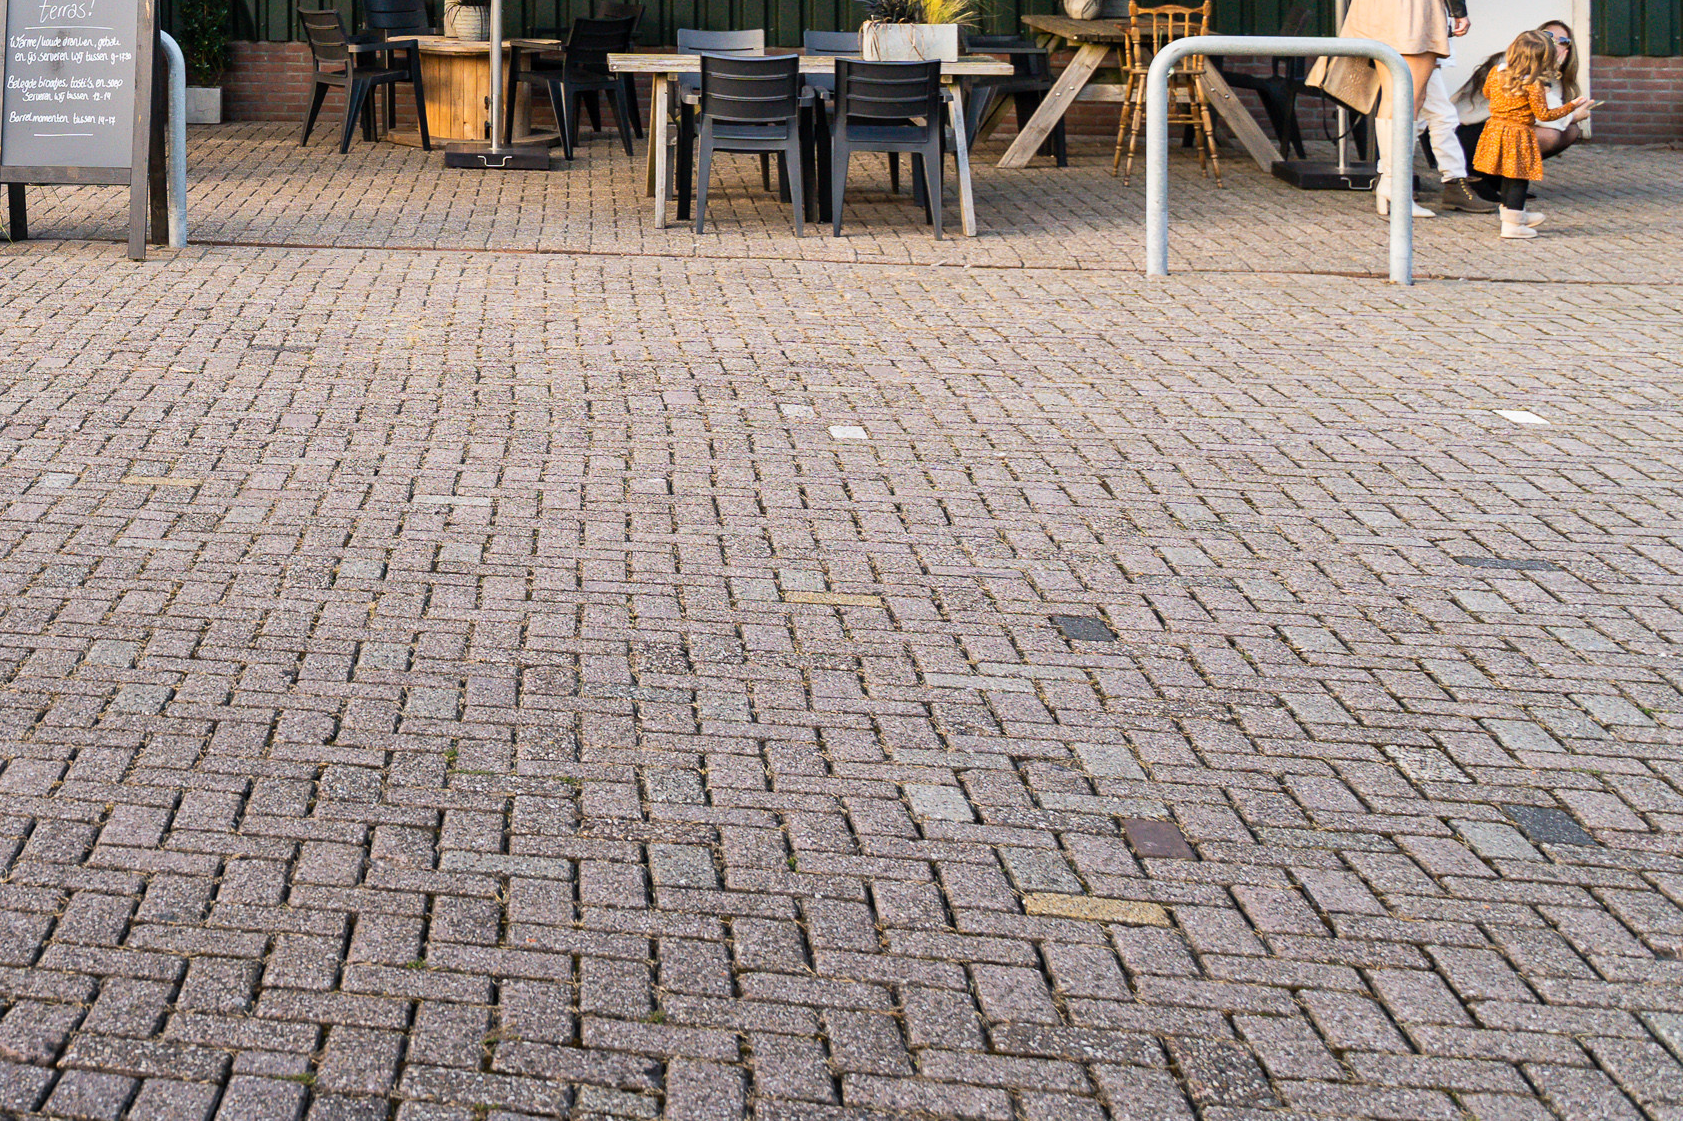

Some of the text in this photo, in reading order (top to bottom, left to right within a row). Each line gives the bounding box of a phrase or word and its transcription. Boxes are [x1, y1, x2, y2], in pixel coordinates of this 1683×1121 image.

[14, 52, 27, 62] en
[37, 52, 70, 62] serveren
[85, 50, 109, 62] tussen
[7, 75, 37, 93] Belegde
[95, 78, 106, 88] en
[105, 78, 124, 90] soep
[66, 90, 90, 101] tussen
[72, 112, 97, 124] tussen
